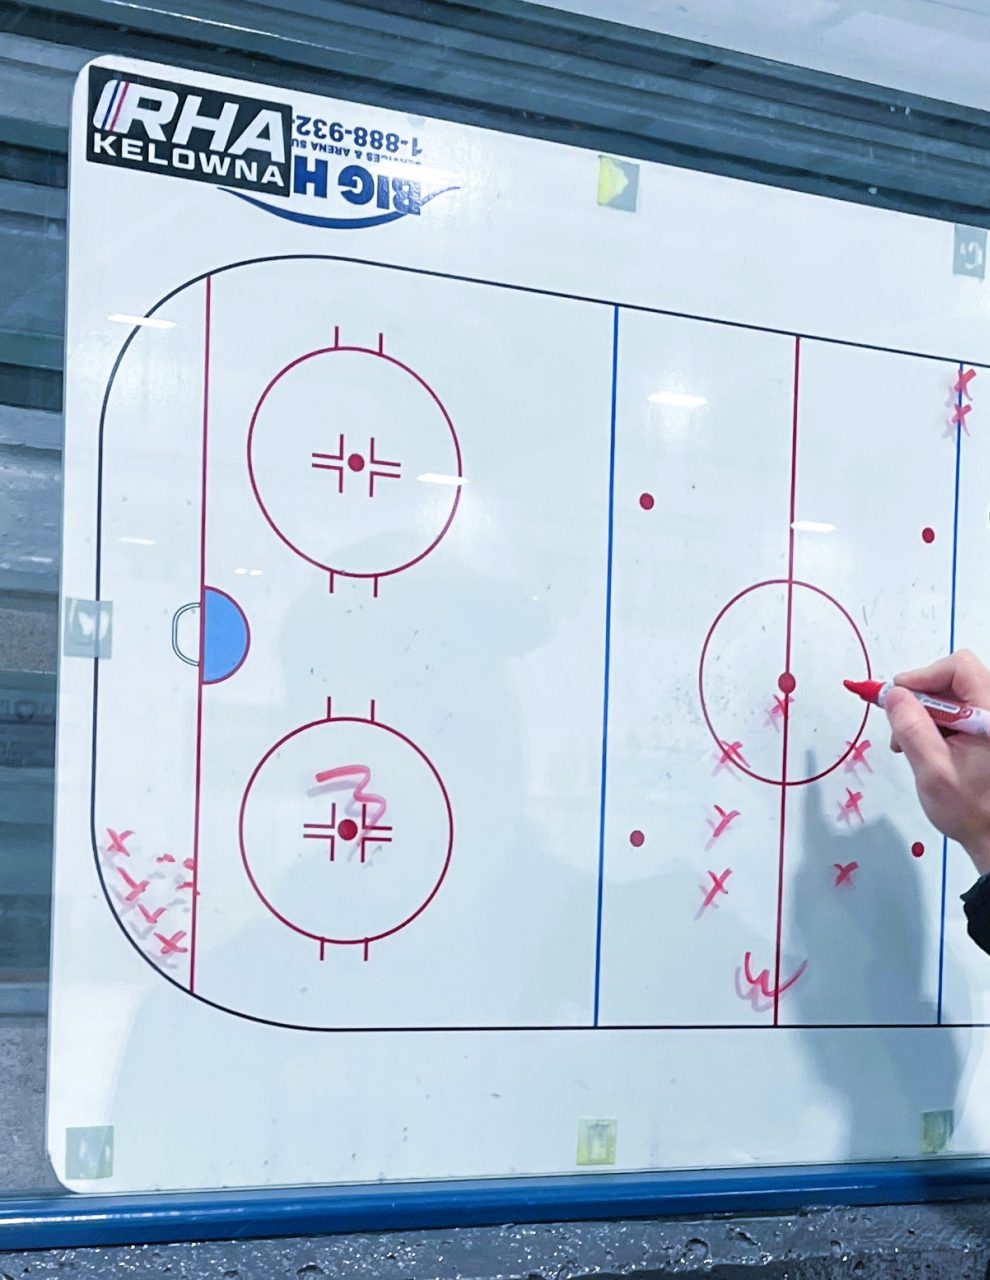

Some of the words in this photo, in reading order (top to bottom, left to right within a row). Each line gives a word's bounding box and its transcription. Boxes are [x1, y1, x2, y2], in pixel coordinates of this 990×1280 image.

[93, 79, 286, 164] RHA
[93, 132, 285, 187] KELOWNA
[310, 141, 350, 157] ARENA
[338, 165, 421, 215] BIG
